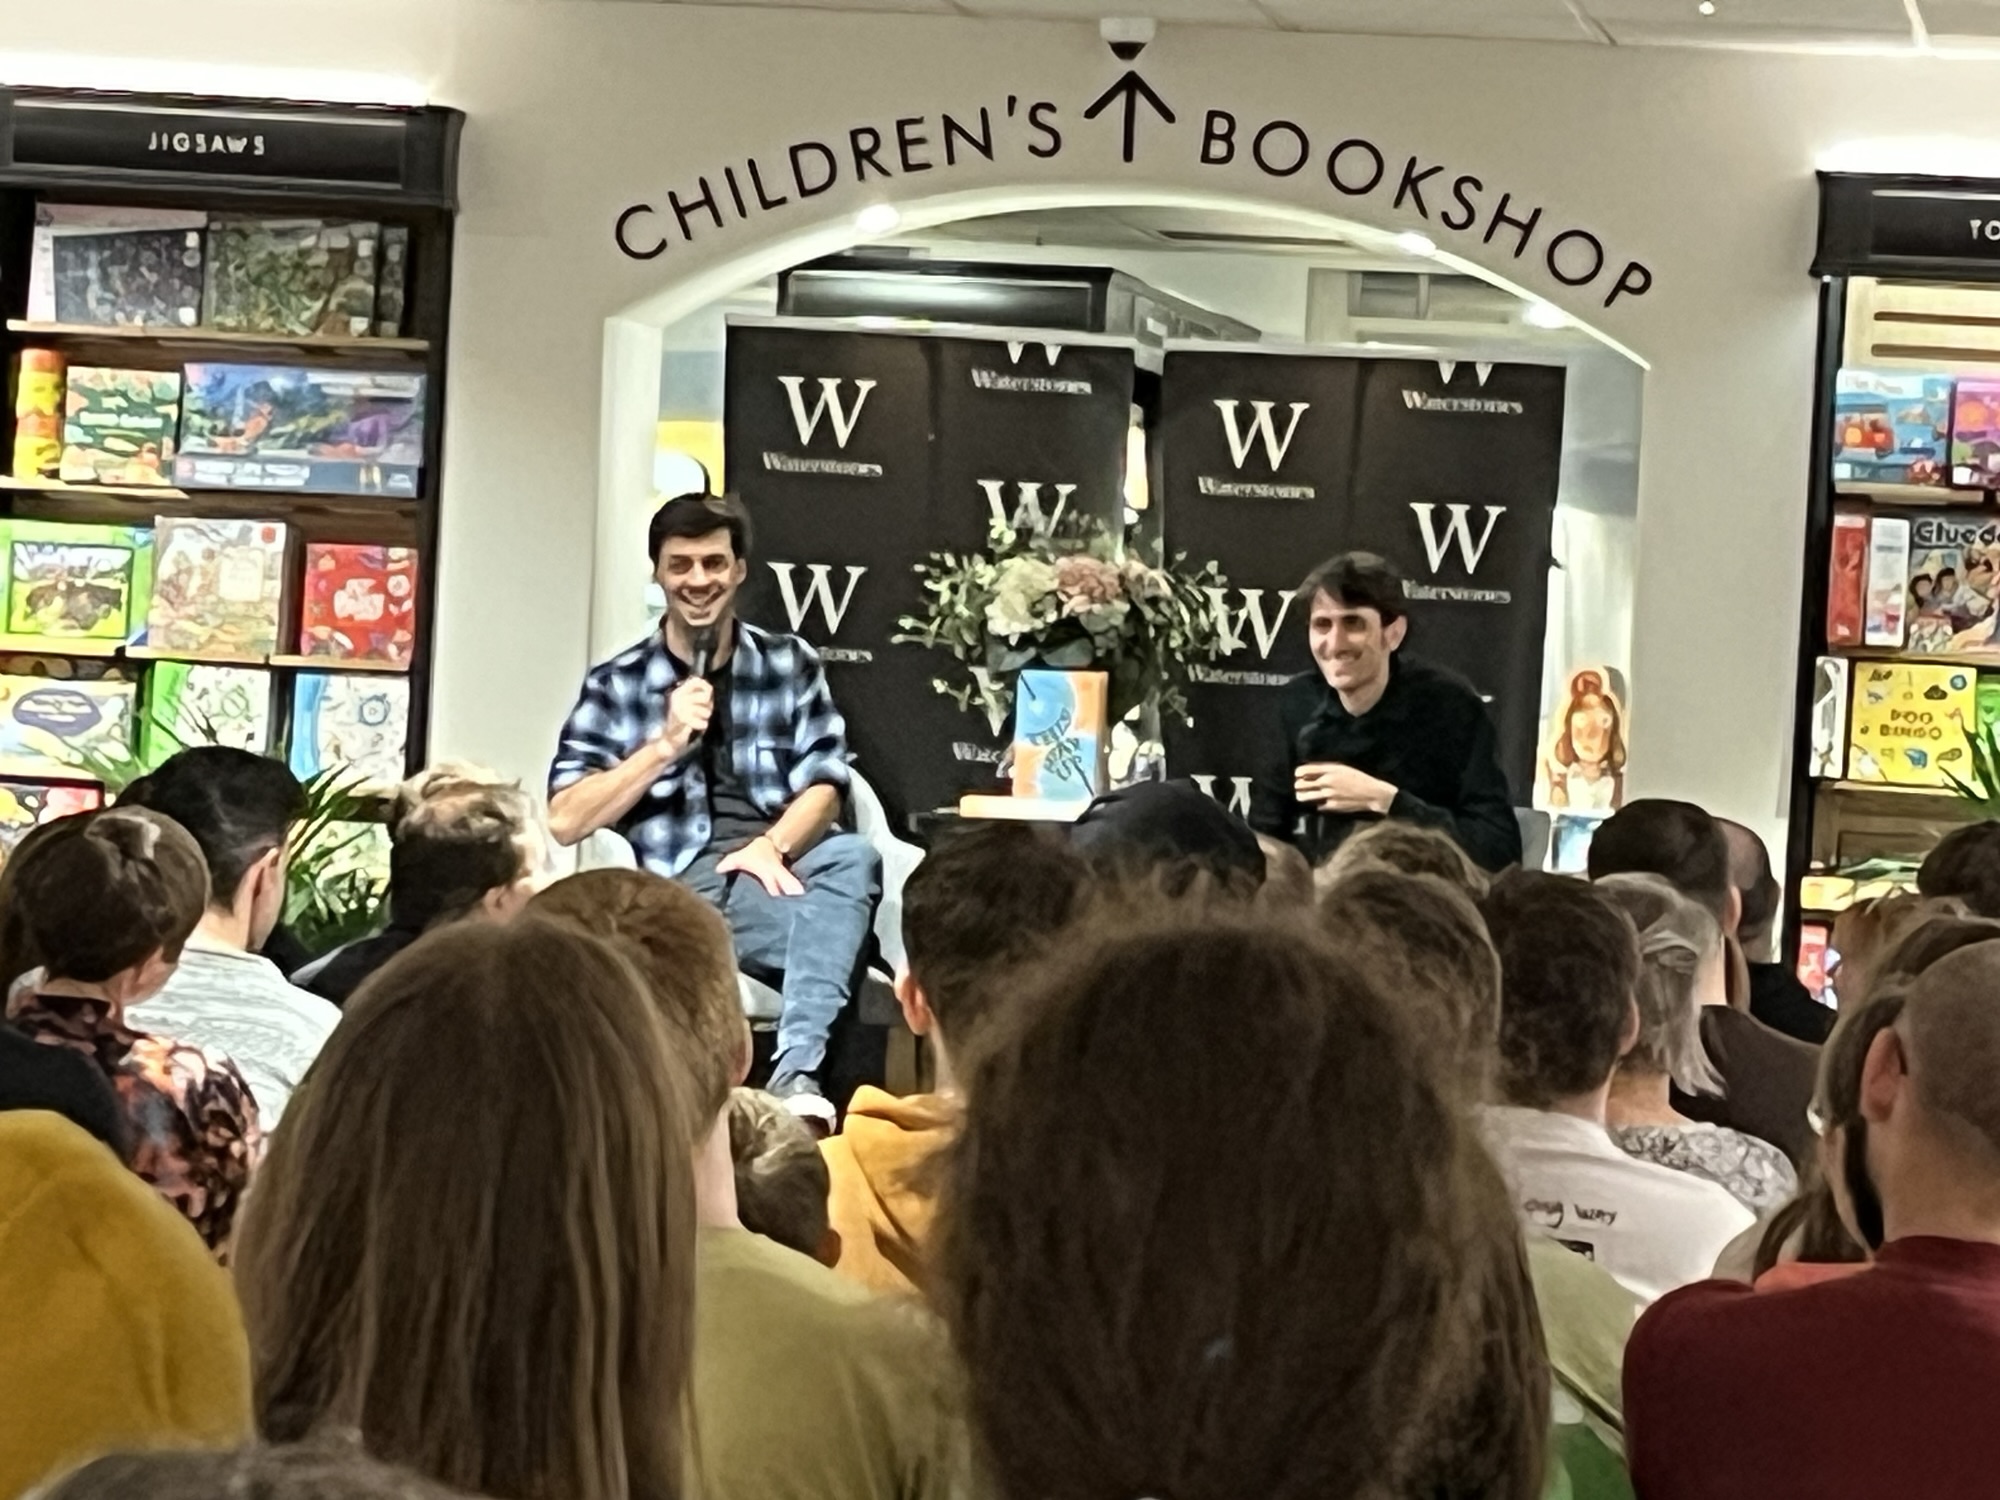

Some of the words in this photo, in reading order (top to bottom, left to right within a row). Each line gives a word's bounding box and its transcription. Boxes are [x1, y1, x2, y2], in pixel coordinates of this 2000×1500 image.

[148, 131, 265, 156] JIGSAWS
[614, 94, 1063, 260] CHILDREN'S
[1199, 109, 1653, 308] BOOKSHOP
[777, 375, 877, 449] W
[1212, 399, 1311, 473] W
[1409, 502, 1507, 575] W
[766, 561, 868, 636] W
[1202, 587, 1298, 660] W
